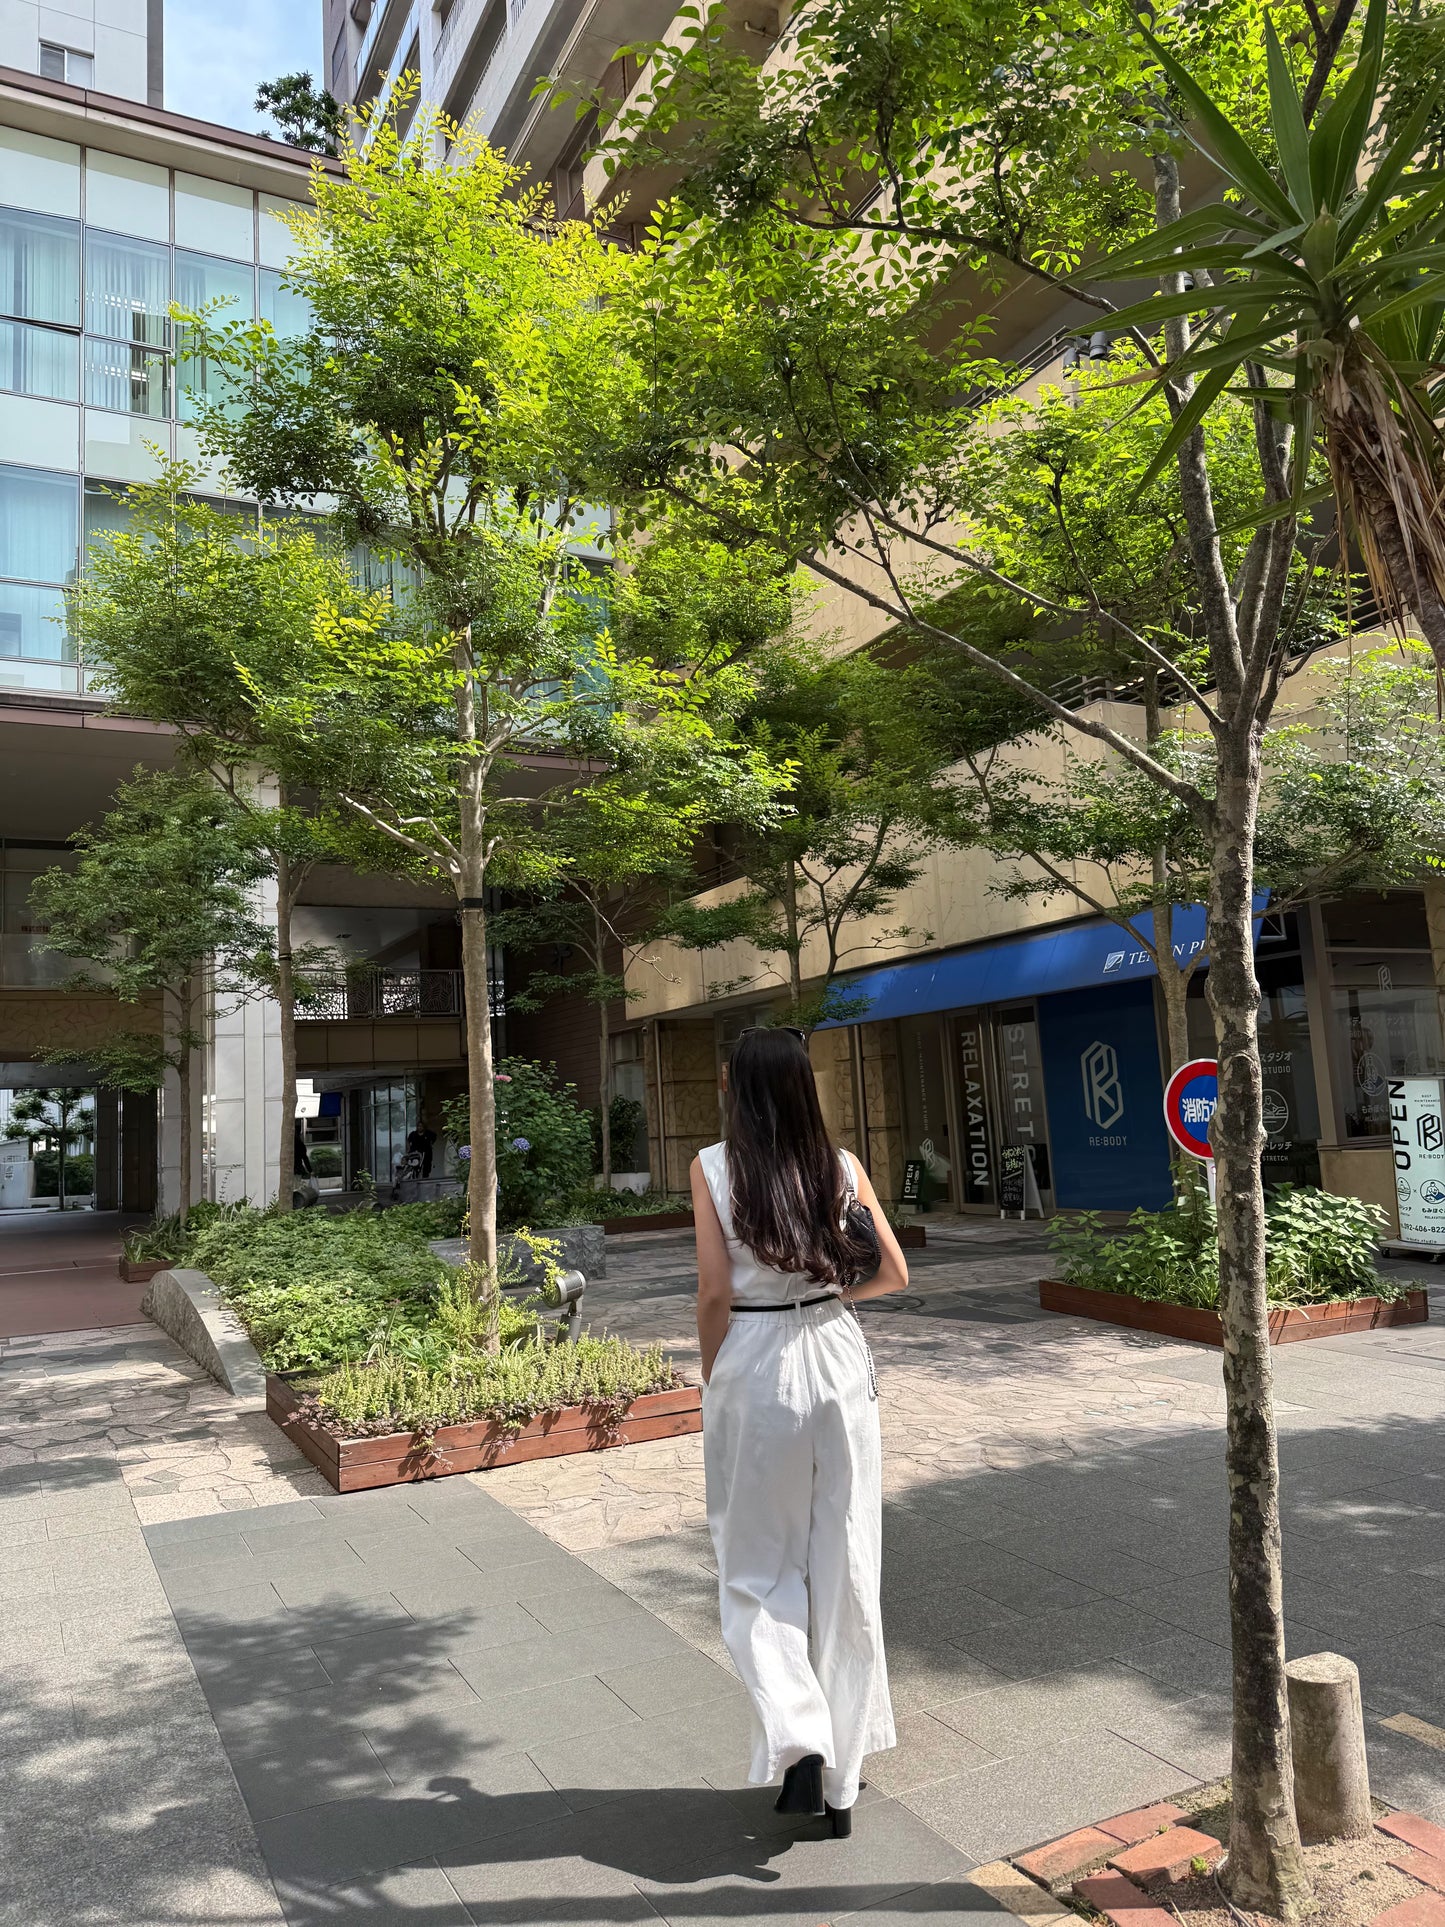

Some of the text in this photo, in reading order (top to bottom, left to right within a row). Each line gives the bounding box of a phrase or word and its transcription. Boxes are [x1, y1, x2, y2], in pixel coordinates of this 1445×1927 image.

[1129, 943, 1185, 965] TEN
[1262, 1065, 1291, 1075] STUDIO
[961, 1031, 989, 1186] RELAXATION
[1388, 1080, 1411, 1171] OPEN
[1089, 1136, 1127, 1146] RE:BODY
[1263, 1141, 1293, 1150] トレッチ
[904, 1164, 915, 1193] OPEN
